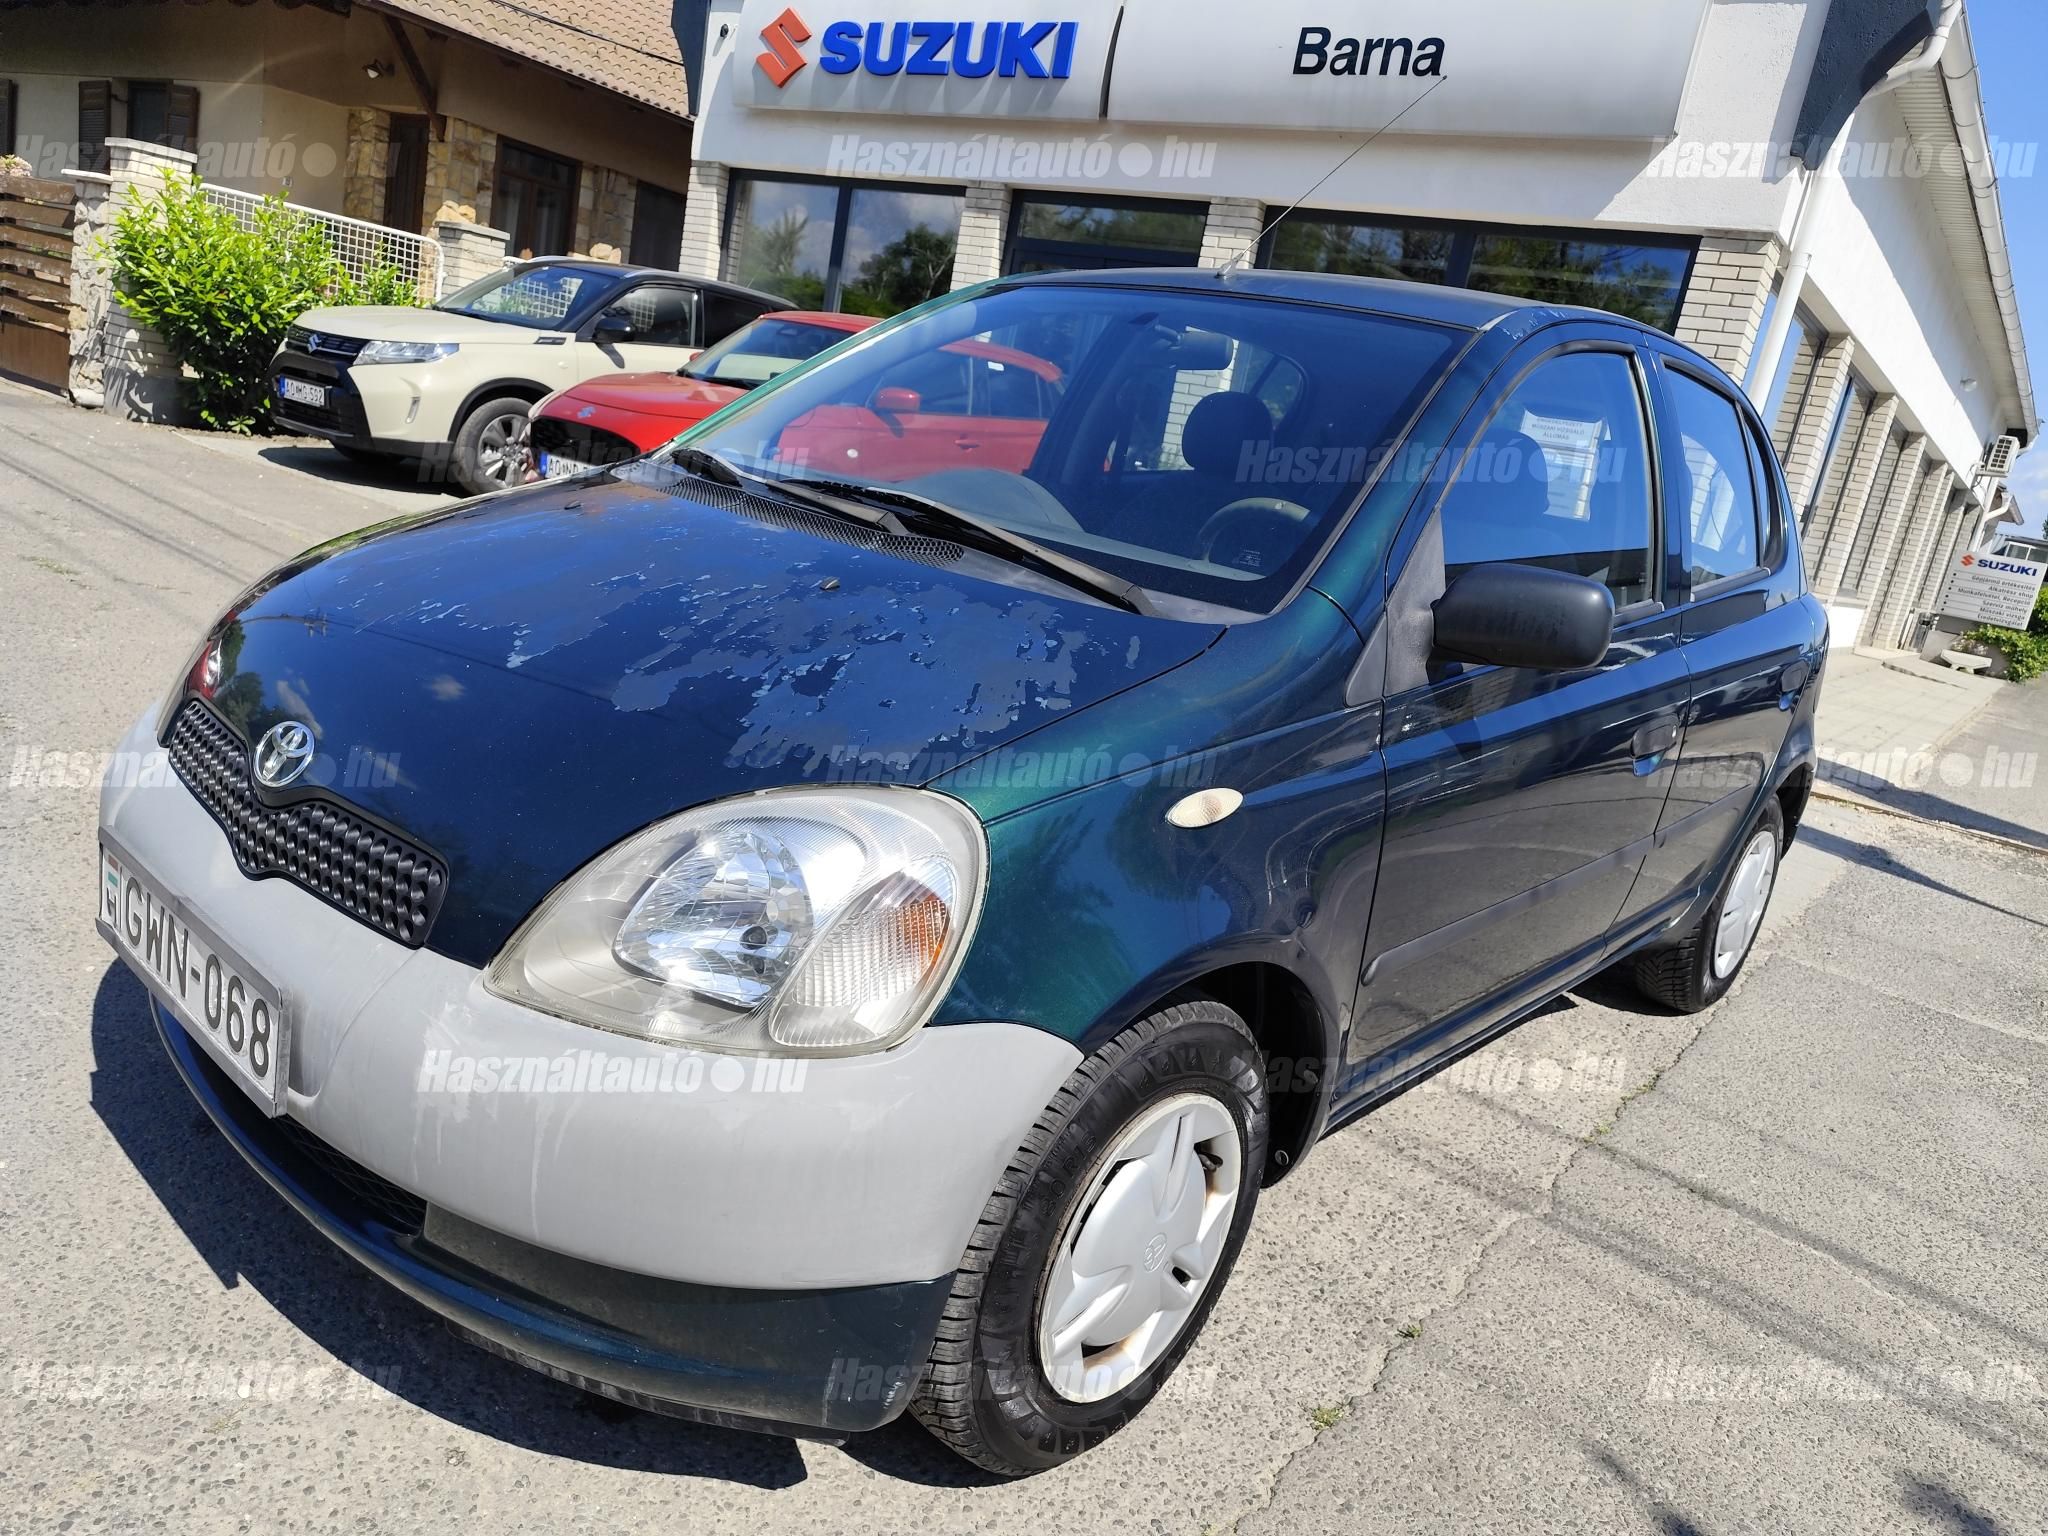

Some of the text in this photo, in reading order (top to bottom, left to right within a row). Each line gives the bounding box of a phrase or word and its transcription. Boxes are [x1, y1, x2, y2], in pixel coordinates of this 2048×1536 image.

[819, 21, 1079, 79] SUZUKI
[1293, 27, 1445, 76] Barna
[1978, 559, 2037, 576] SUZUKI
[2002, 596, 2031, 606] Recepció
[2018, 591, 2034, 599] shop
[1982, 600, 2004, 609] Szerviz
[2006, 612, 2025, 621] vizsga
[125, 876, 271, 1078] GWN-068
